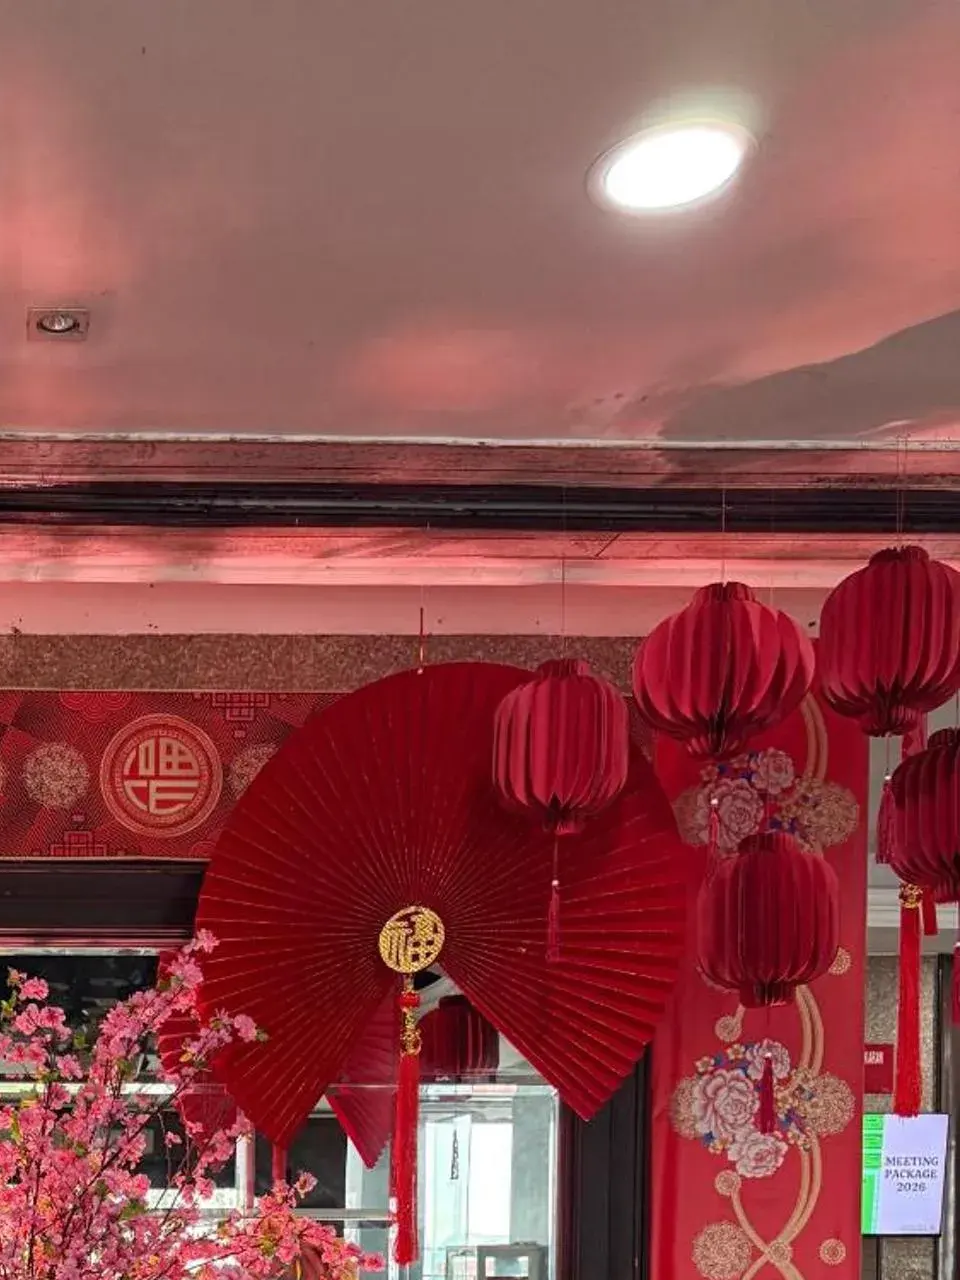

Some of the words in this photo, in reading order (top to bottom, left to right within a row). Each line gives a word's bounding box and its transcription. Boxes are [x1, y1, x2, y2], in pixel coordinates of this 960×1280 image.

[884, 1156, 939, 1166] MEETING
[884, 1169, 937, 1179] PACKAGE
[896, 1182, 927, 1192] 2026
